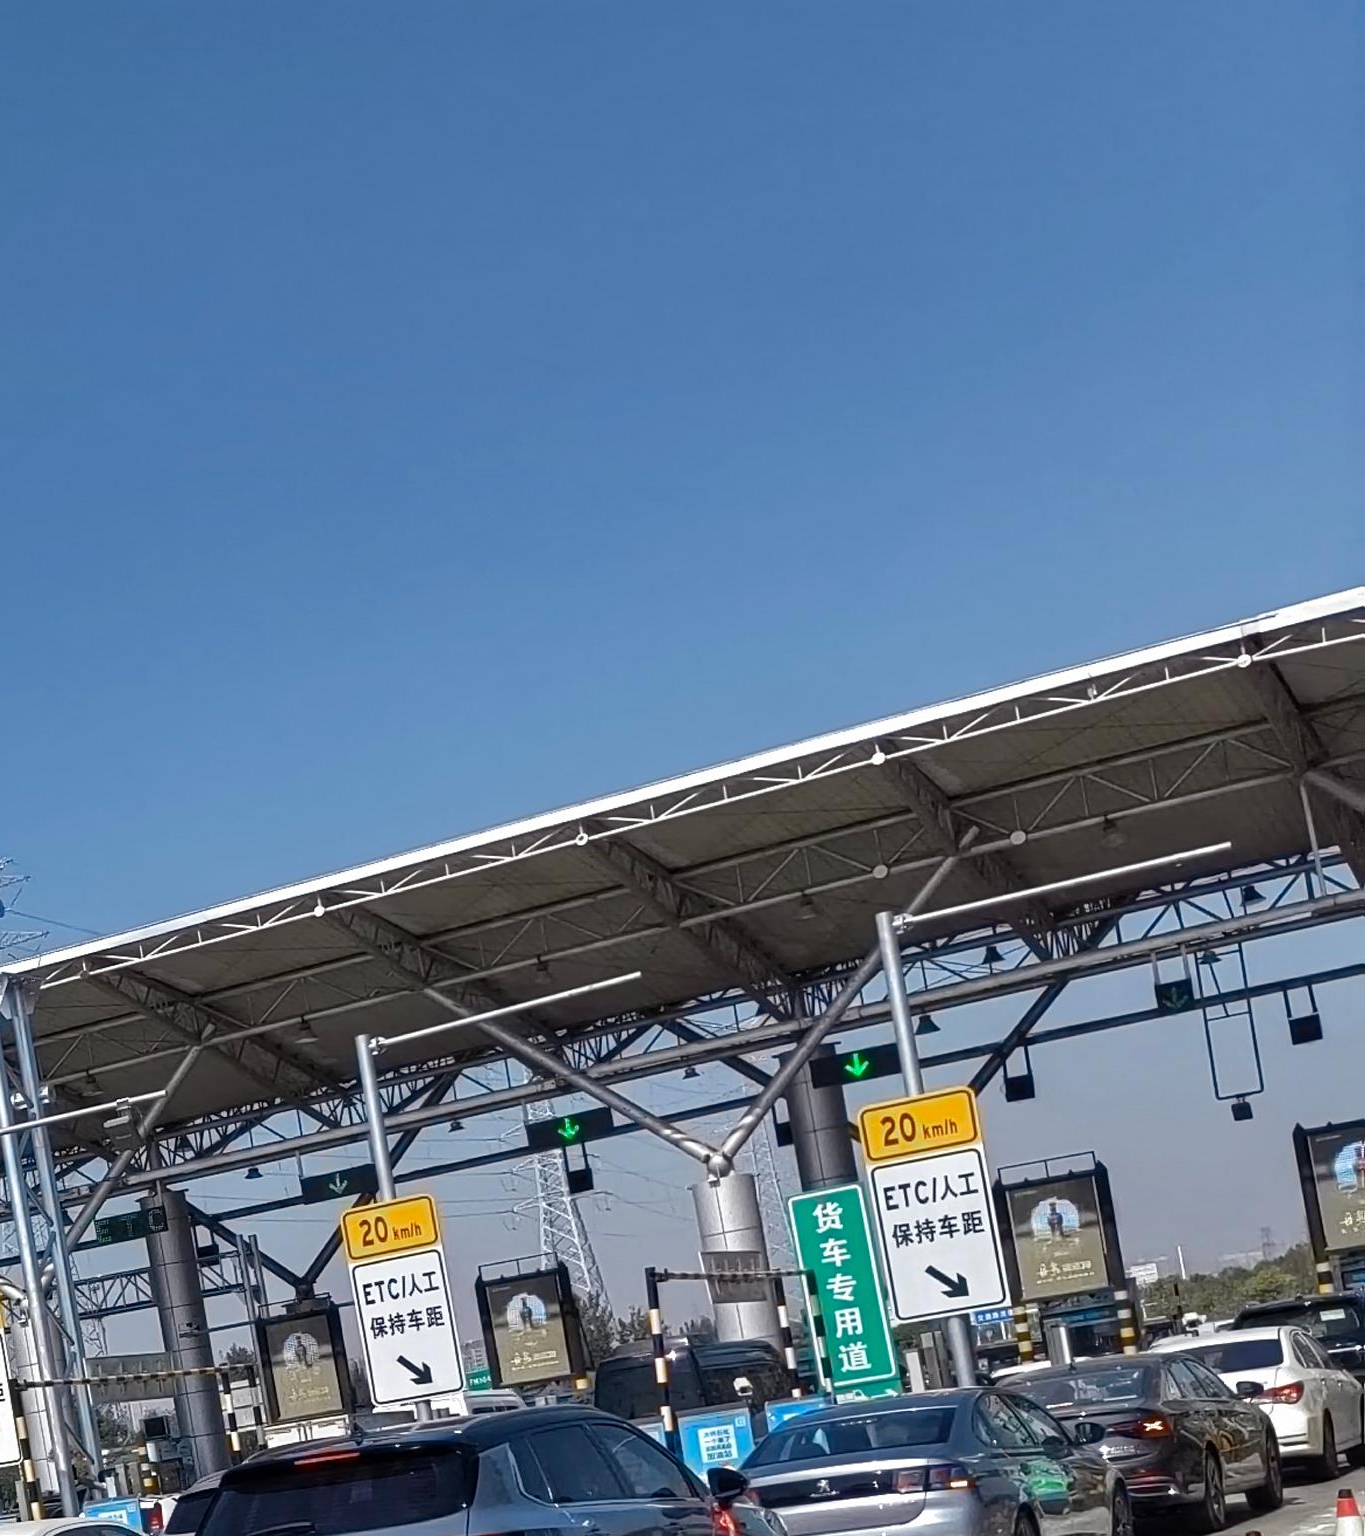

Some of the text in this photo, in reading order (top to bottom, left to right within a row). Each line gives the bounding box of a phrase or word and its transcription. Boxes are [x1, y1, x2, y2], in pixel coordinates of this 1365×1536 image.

[880, 1112, 958, 1147] 20 km/h
[884, 1171, 980, 1212] ETC/人工
[358, 1216, 422, 1248] 20 km/h
[891, 1211, 985, 1249] 保持车距
[363, 1271, 440, 1306] ETC/人工
[812, 1201, 871, 1373] 货车专用道
[370, 1306, 445, 1339] 保持车距
